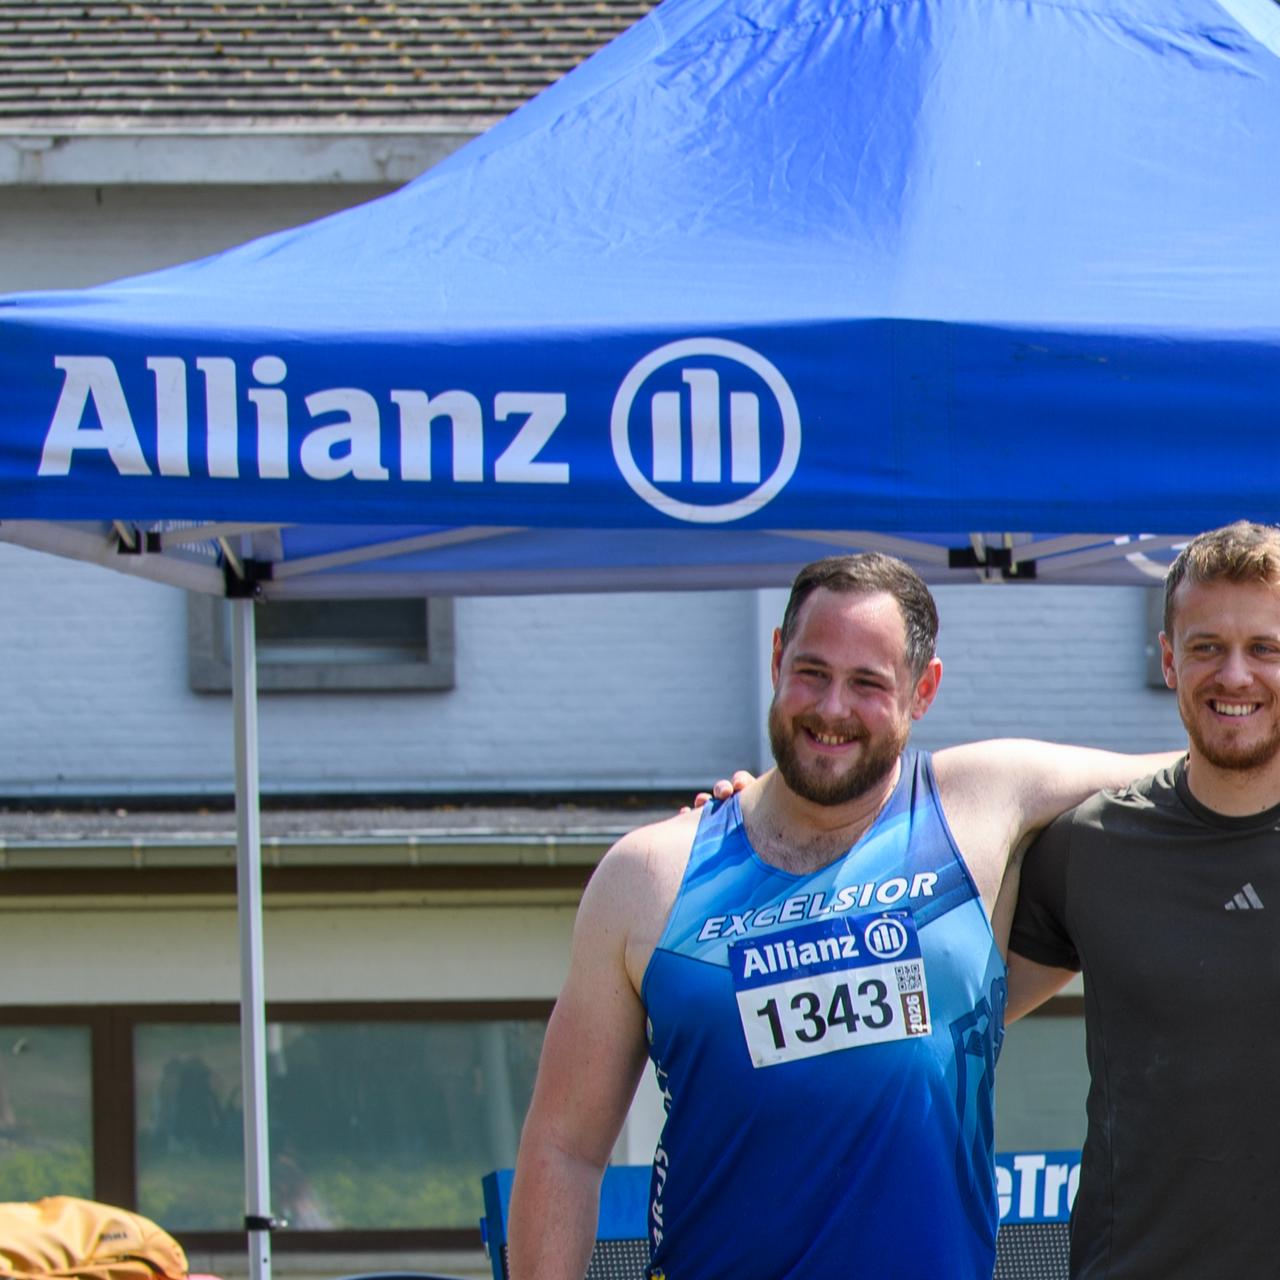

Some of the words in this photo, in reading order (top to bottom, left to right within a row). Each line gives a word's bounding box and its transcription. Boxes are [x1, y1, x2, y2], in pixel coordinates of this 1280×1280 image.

[37, 355, 571, 484] Allianz
[697, 872, 939, 943] EXCELSIOR
[743, 935, 860, 979] Allianz
[756, 979, 893, 1050] 1343
[907, 994, 924, 1034] 2026
